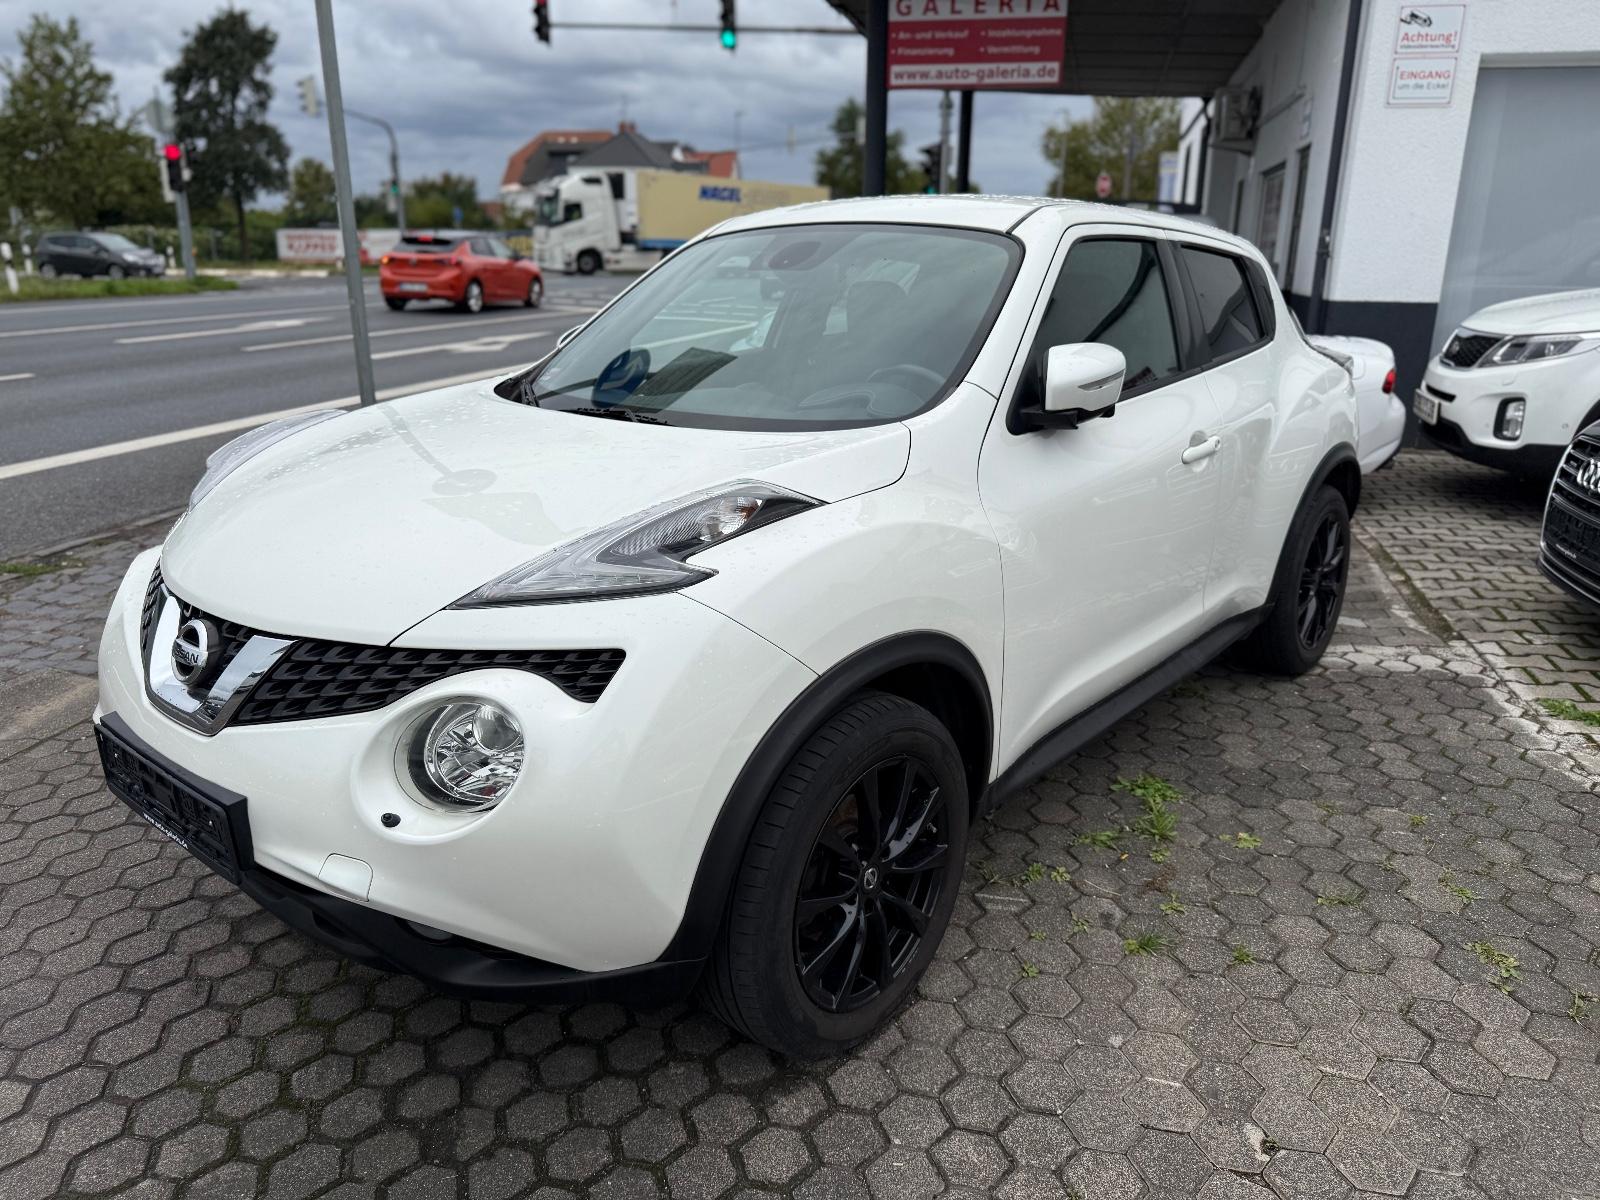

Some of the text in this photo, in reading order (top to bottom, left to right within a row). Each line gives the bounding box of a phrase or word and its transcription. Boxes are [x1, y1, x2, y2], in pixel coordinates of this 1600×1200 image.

[896, 0, 1061, 16] GALERIA
[935, 29, 969, 39] Verkauf
[1401, 30, 1458, 44] Achtung!
[897, 47, 954, 57] Finanzierung
[987, 45, 1041, 55] Vermittlung
[894, 65, 1057, 81] www.auto-galeria.de
[1400, 70, 1451, 80] EINGANG
[1413, 82, 1424, 90] die
[174, 644, 200, 664] SSAN
